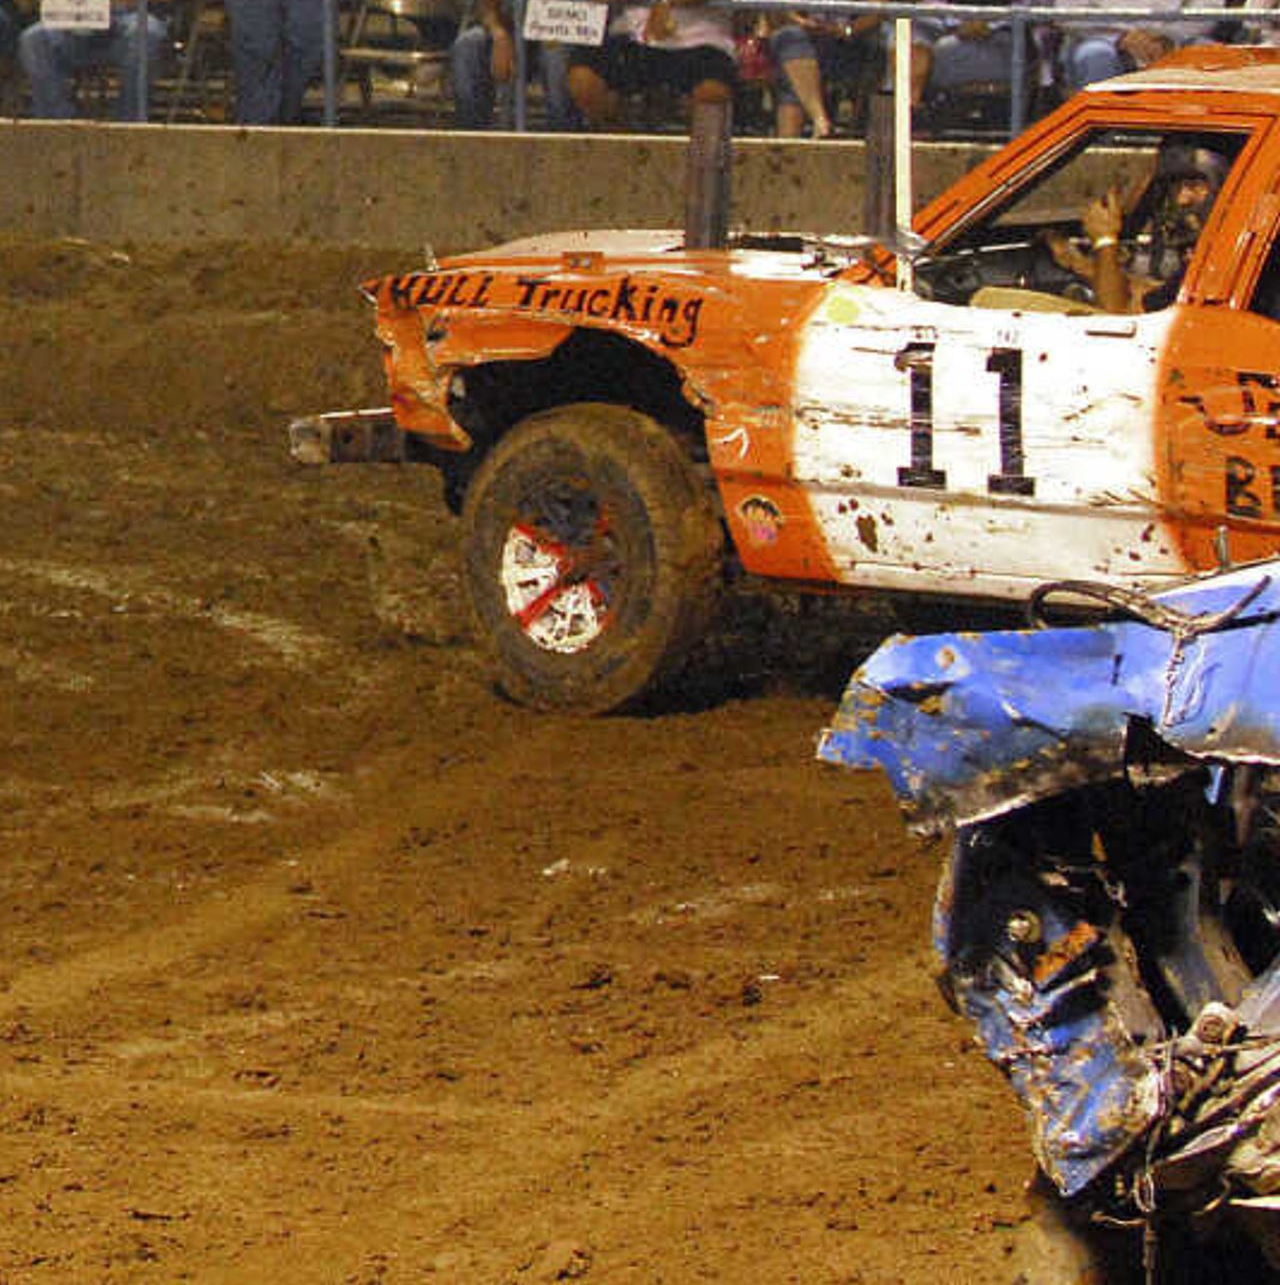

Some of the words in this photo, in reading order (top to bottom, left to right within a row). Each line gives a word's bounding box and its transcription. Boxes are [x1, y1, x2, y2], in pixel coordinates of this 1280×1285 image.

[389, 274, 494, 309] HULL
[516, 276, 705, 349] Trucking
[894, 342, 1036, 497] 11
